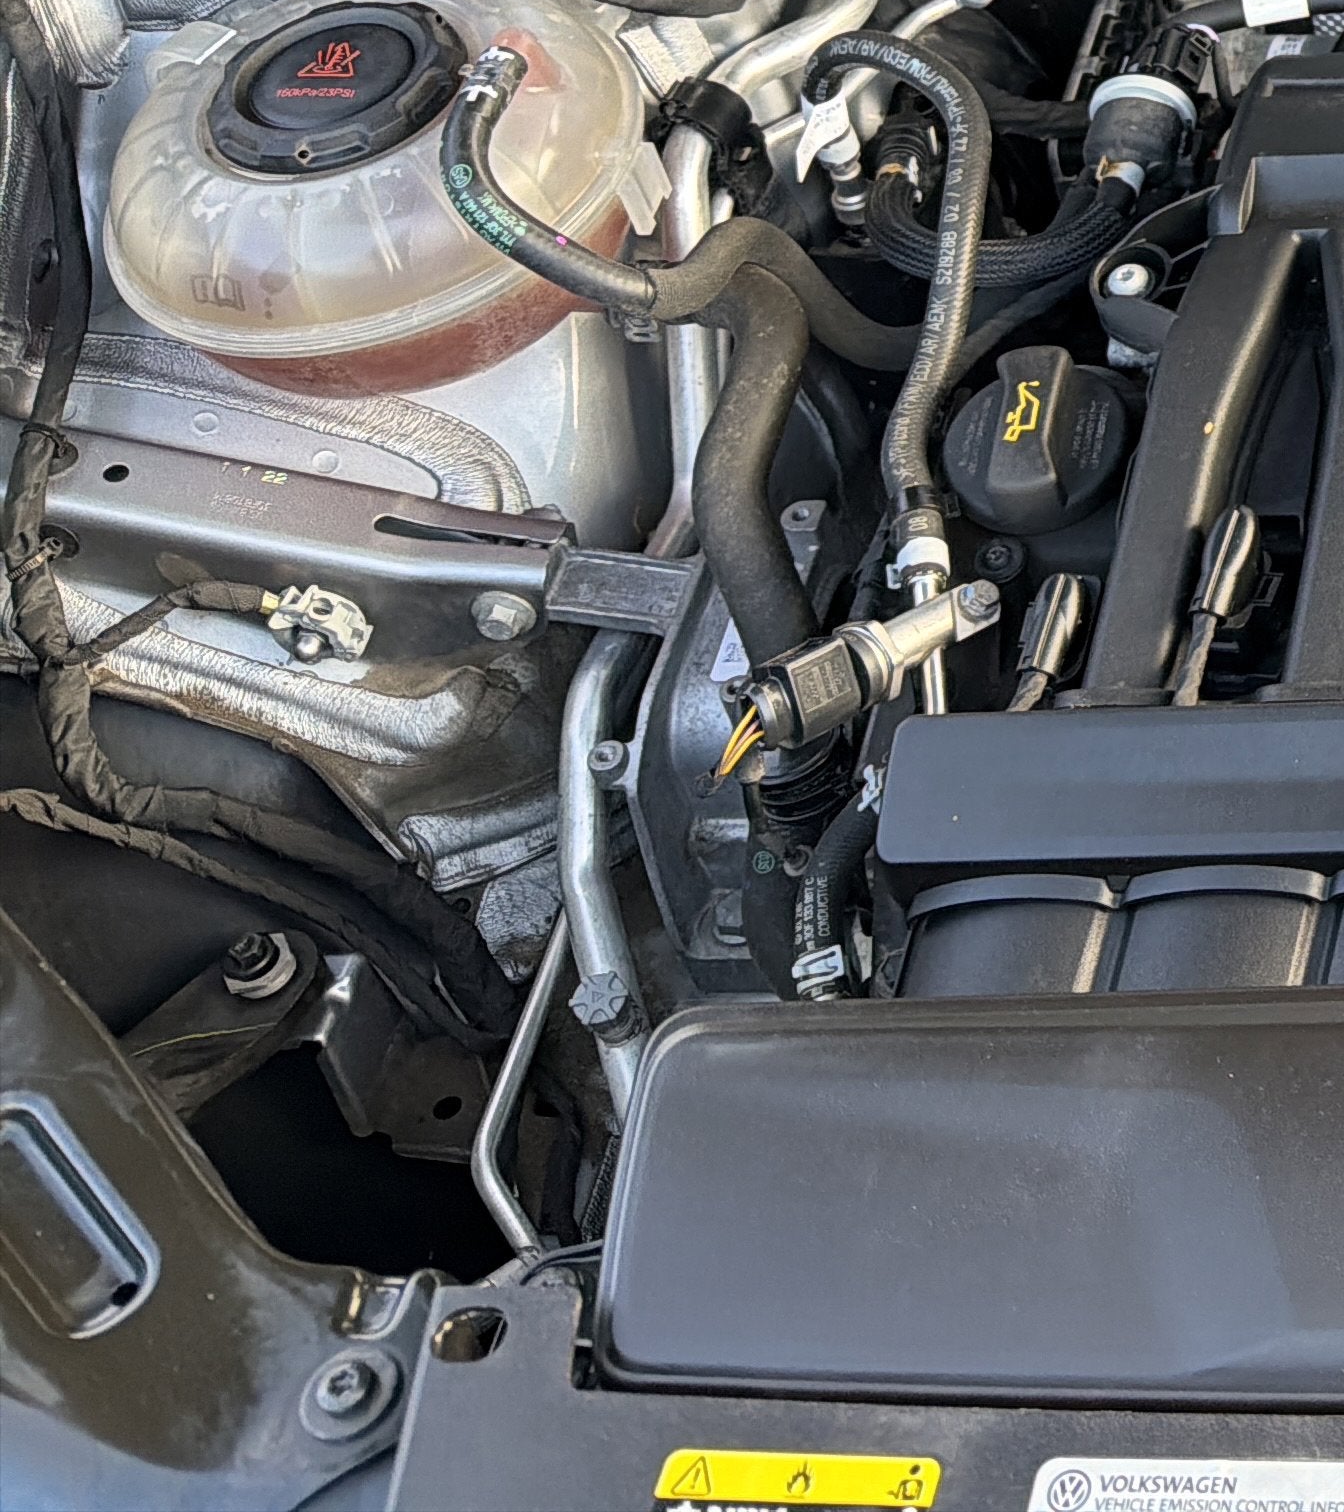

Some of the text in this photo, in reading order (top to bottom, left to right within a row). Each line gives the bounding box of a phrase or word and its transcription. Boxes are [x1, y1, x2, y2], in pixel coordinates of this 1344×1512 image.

[817, 875, 831, 937] CONDUCTIVE
[1100, 1475, 1238, 1494] VOLKSWAGEN
[1095, 1497, 1156, 1511] VEHICLE
[1160, 1498, 1232, 1512] EMISSION
[1236, 1499, 1305, 1512] CONTROL
